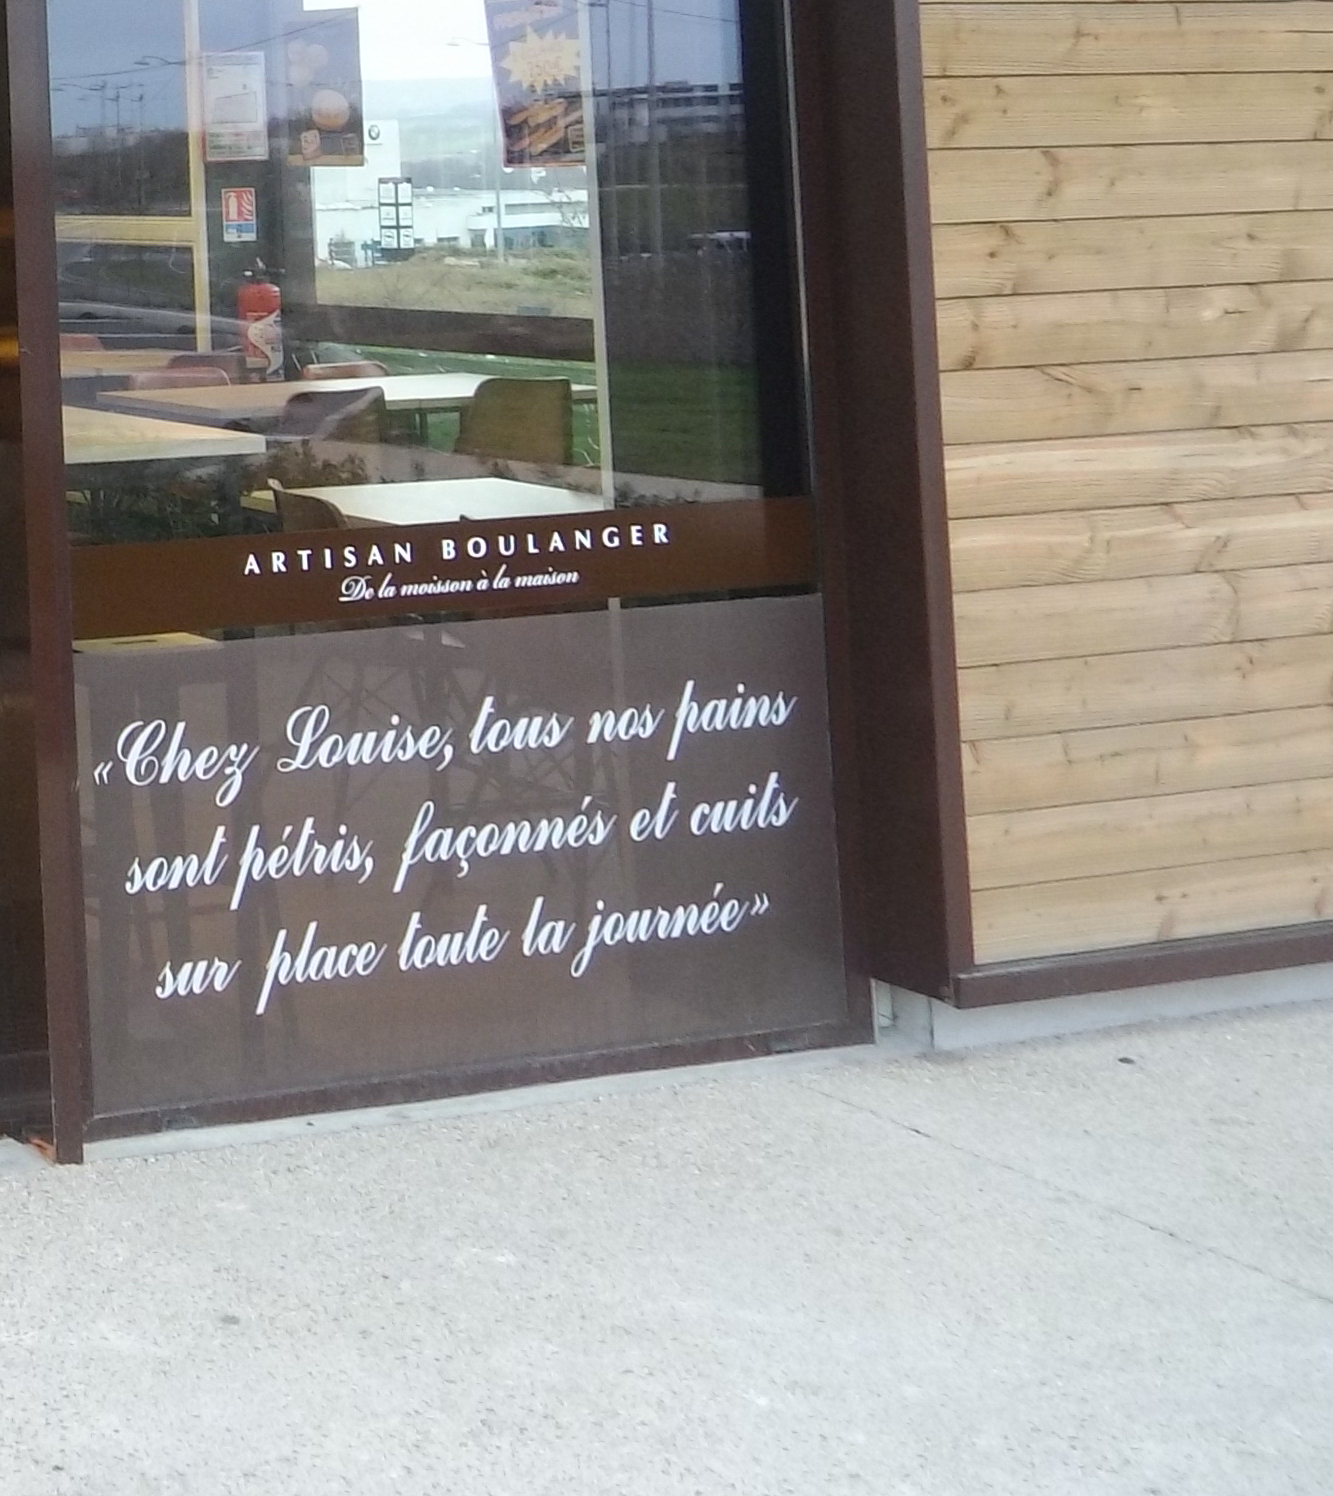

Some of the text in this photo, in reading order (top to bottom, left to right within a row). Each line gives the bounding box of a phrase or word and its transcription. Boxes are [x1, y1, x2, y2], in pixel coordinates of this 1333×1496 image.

[244, 523, 670, 576] ARTISAN BOULANGER
[338, 564, 579, 602] De la moisson à la maison
[277, 704, 454, 772] Louise,
[468, 695, 572, 756] tous
[587, 706, 665, 744] nos
[667, 679, 799, 761] pains
[125, 771, 799, 910] sont pétris, façonnés et cuits
[155, 959, 243, 1000] sur
[256, 920, 387, 1015] place
[398, 904, 511, 973] toute
[521, 896, 580, 957] la
